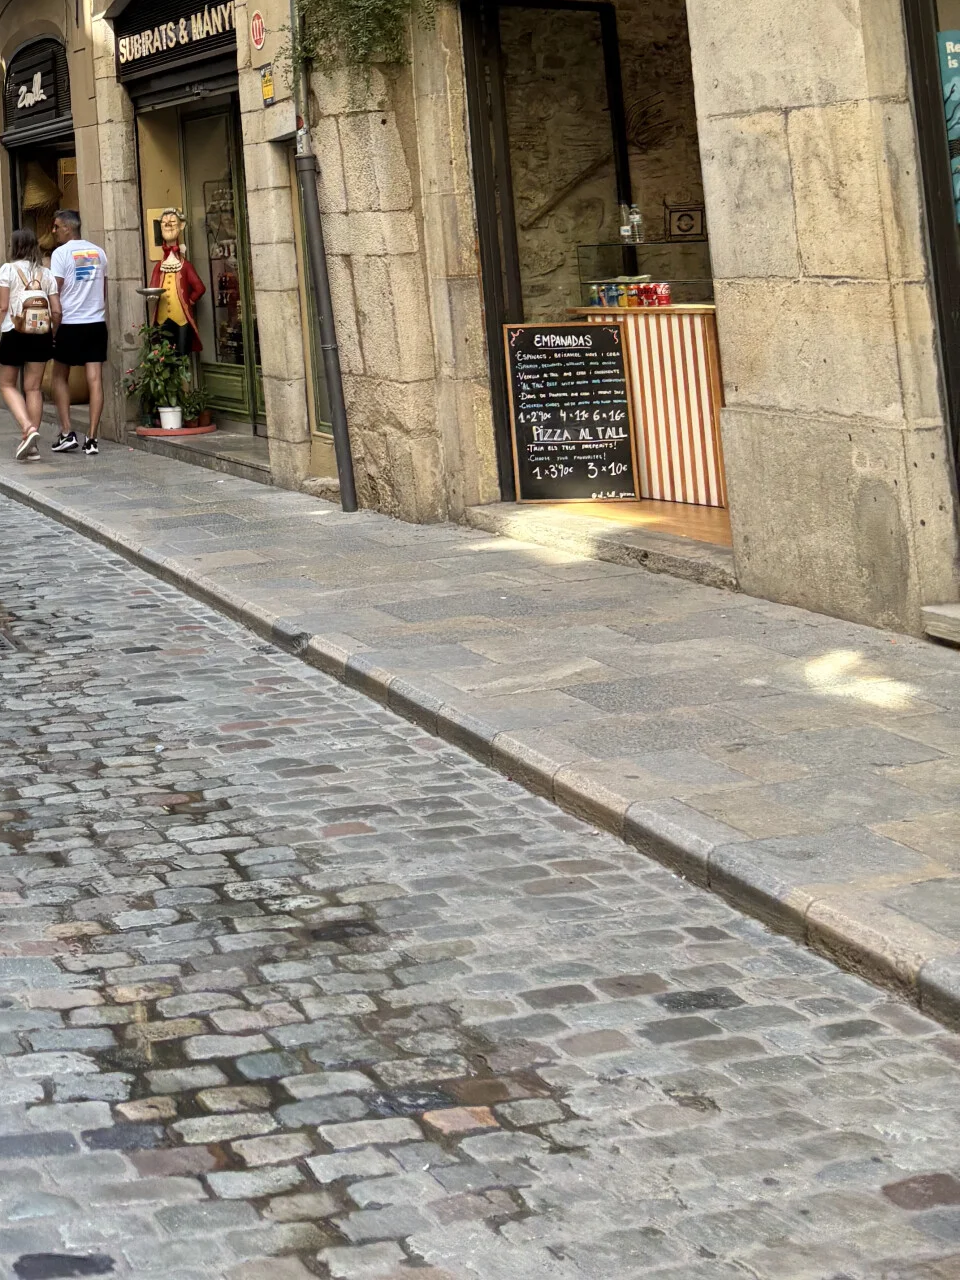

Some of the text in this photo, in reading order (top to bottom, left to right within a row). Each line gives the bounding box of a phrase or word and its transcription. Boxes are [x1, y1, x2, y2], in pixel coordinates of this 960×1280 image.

[119, 0, 236, 64] SUBIRATS & MÁNY
[534, 334, 592, 346] EMPANADAS
[579, 428, 593, 440] AL
[596, 426, 628, 439] TALL
